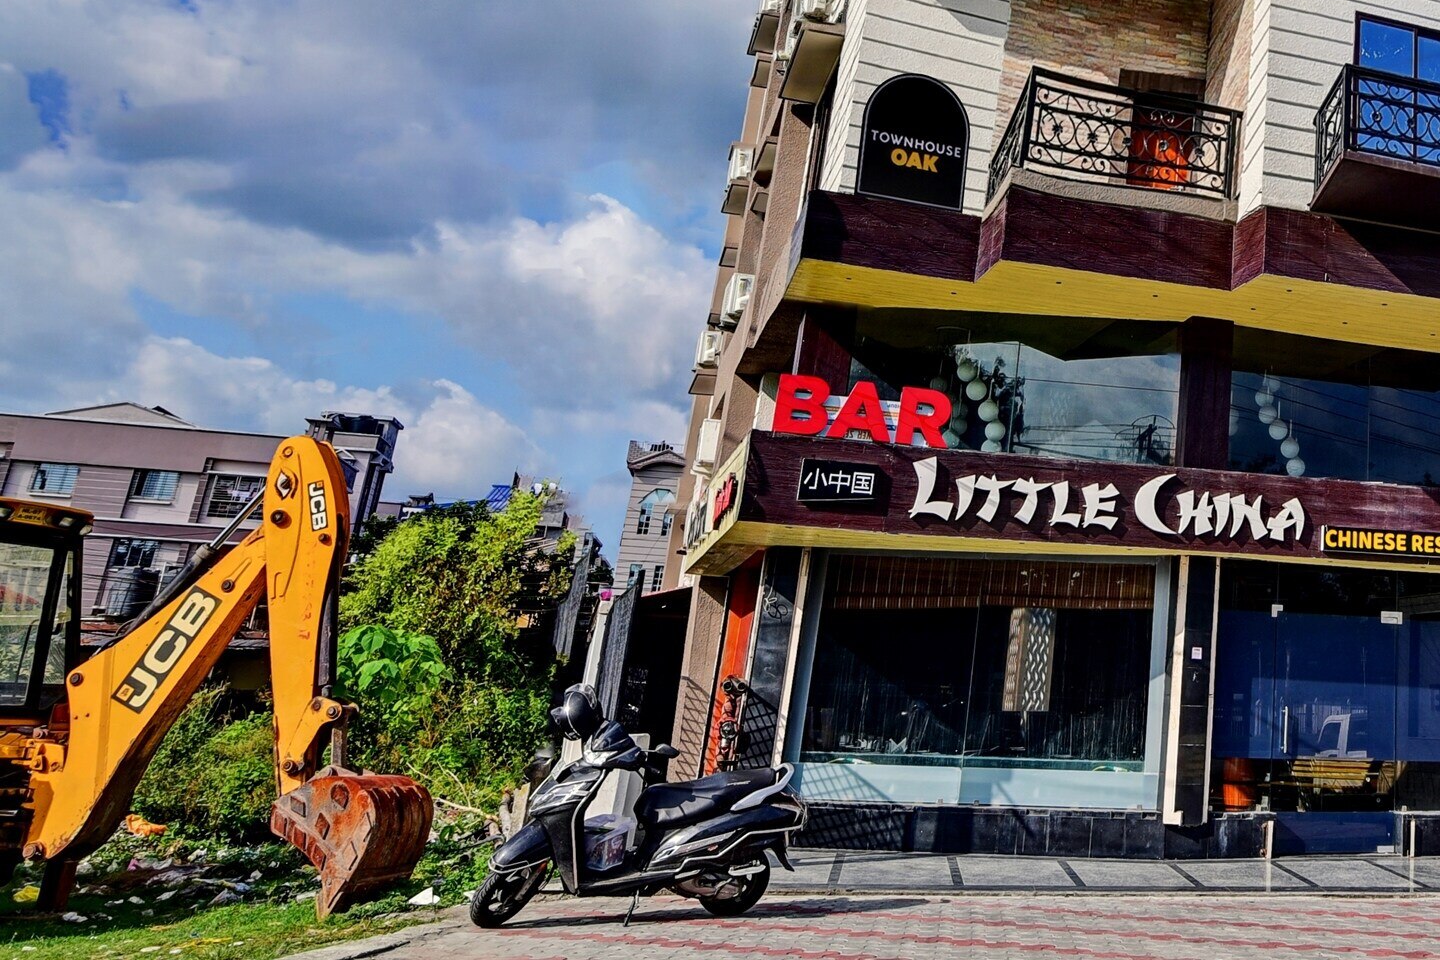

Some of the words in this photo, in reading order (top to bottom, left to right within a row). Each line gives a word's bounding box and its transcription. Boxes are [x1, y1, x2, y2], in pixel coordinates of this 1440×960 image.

[871, 129, 962, 158] TOWNHOUSE
[891, 148, 939, 173] OAK
[773, 373, 952, 450] BAR
[803, 468, 875, 497] 小中国
[908, 455, 1121, 531] LITTLE
[1134, 473, 1306, 542] CHINA
[307, 482, 328, 531] JCB
[1325, 528, 1408, 552] CHINESE
[128, 591, 216, 708] JCB
